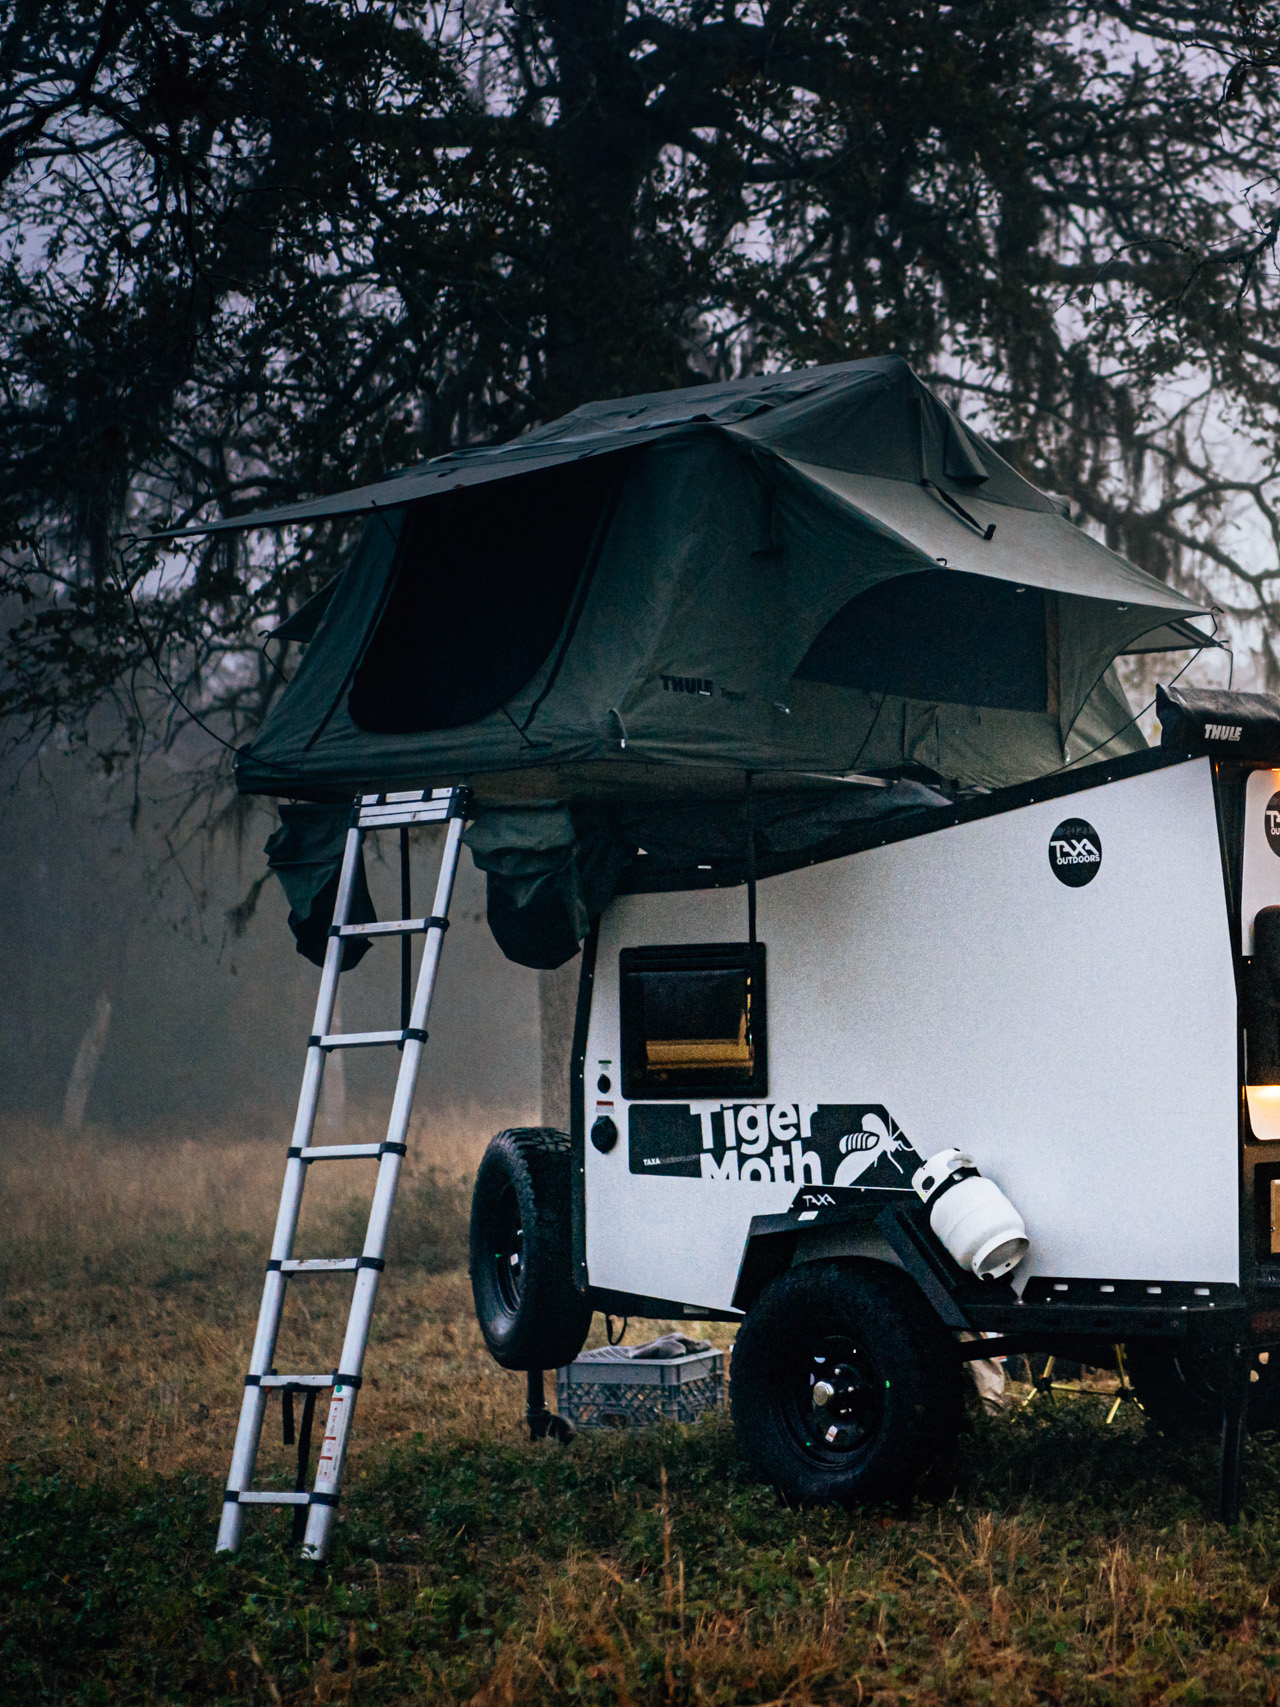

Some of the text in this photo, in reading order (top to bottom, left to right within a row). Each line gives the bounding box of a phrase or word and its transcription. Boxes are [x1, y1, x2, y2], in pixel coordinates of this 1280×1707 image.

[660, 674, 713, 696] THULE
[1204, 723, 1243, 741] THULE
[1049, 838, 1100, 857] TAXA
[1056, 854, 1101, 866] OUTDOORS
[689, 1103, 819, 1155] Tiger
[700, 1140, 823, 1186] Moth
[802, 1193, 836, 1207] TAXA
